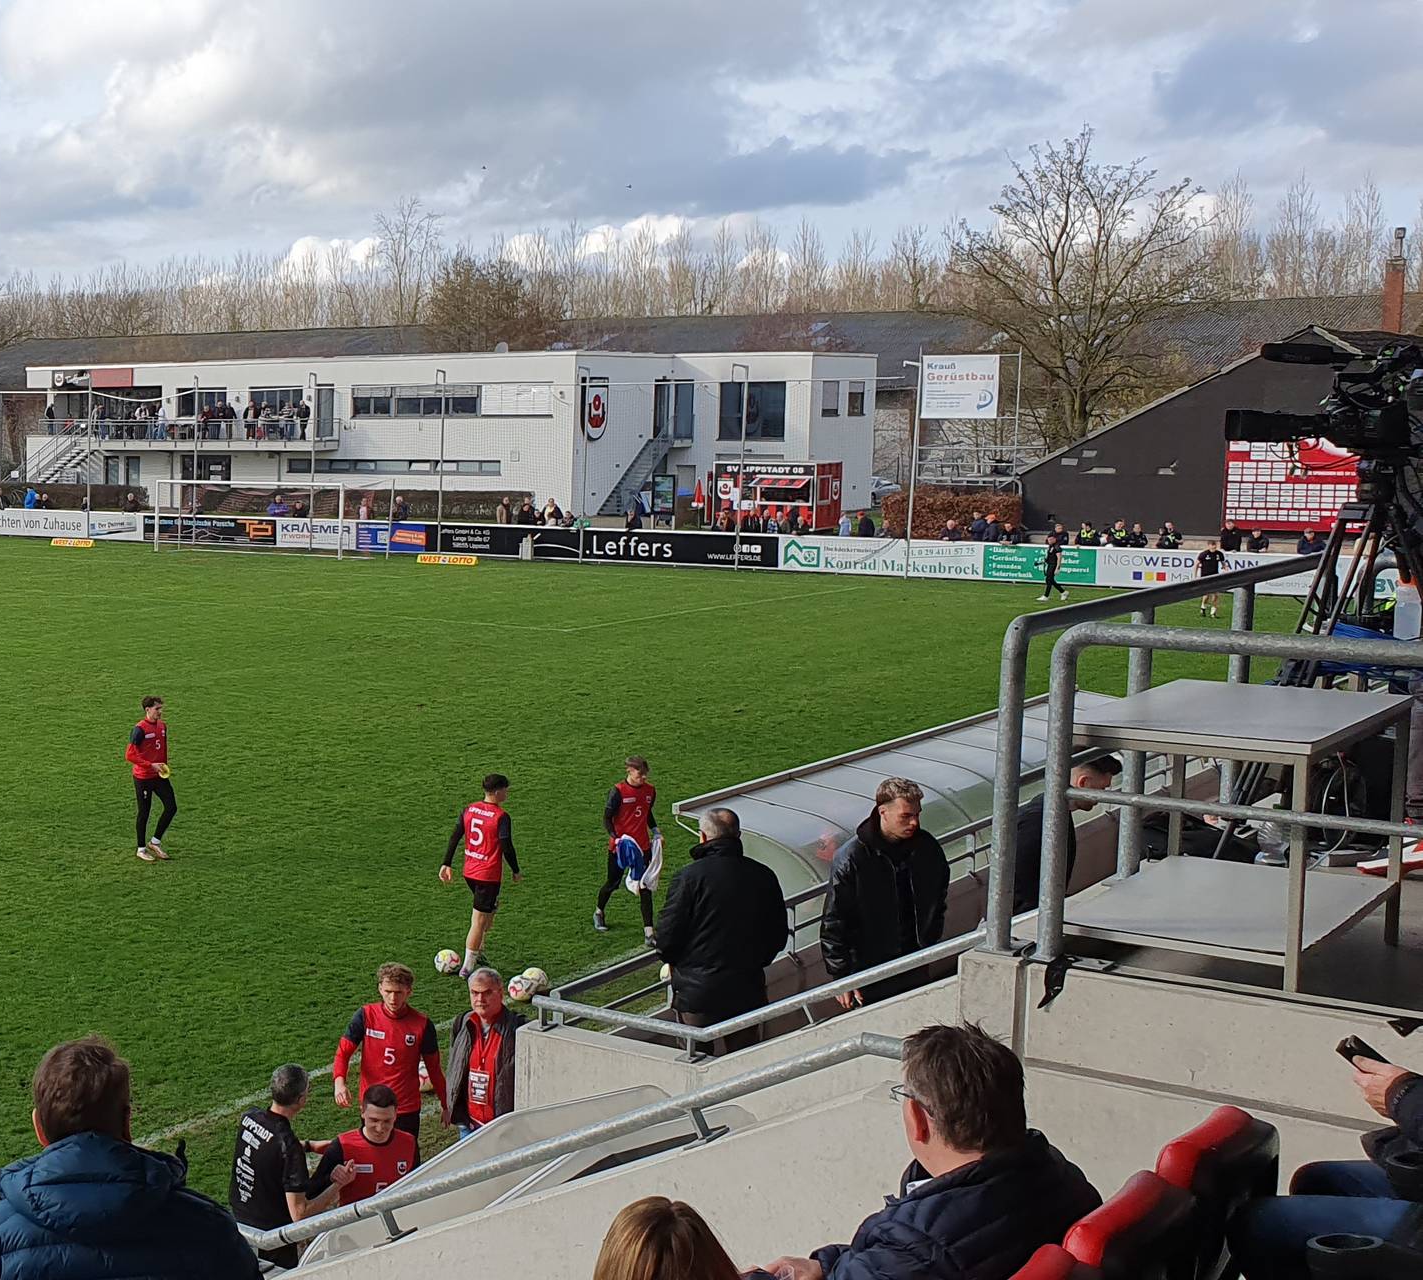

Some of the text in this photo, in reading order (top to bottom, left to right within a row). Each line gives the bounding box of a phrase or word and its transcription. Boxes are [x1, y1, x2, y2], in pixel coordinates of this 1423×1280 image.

[927, 362, 956, 370] Krauß
[927, 371, 995, 381] Gerüstbau
[726, 465, 739, 473] SV
[24, 519, 41, 529] von
[43, 517, 82, 531] Zuhause
[824, 556, 876, 571] Konrad
[155, 739, 161, 750] 5
[634, 805, 642, 817] 5
[469, 817, 484, 846] 5
[383, 1047, 396, 1065] 5
[241, 1115, 274, 1143] LIPPSTADT
